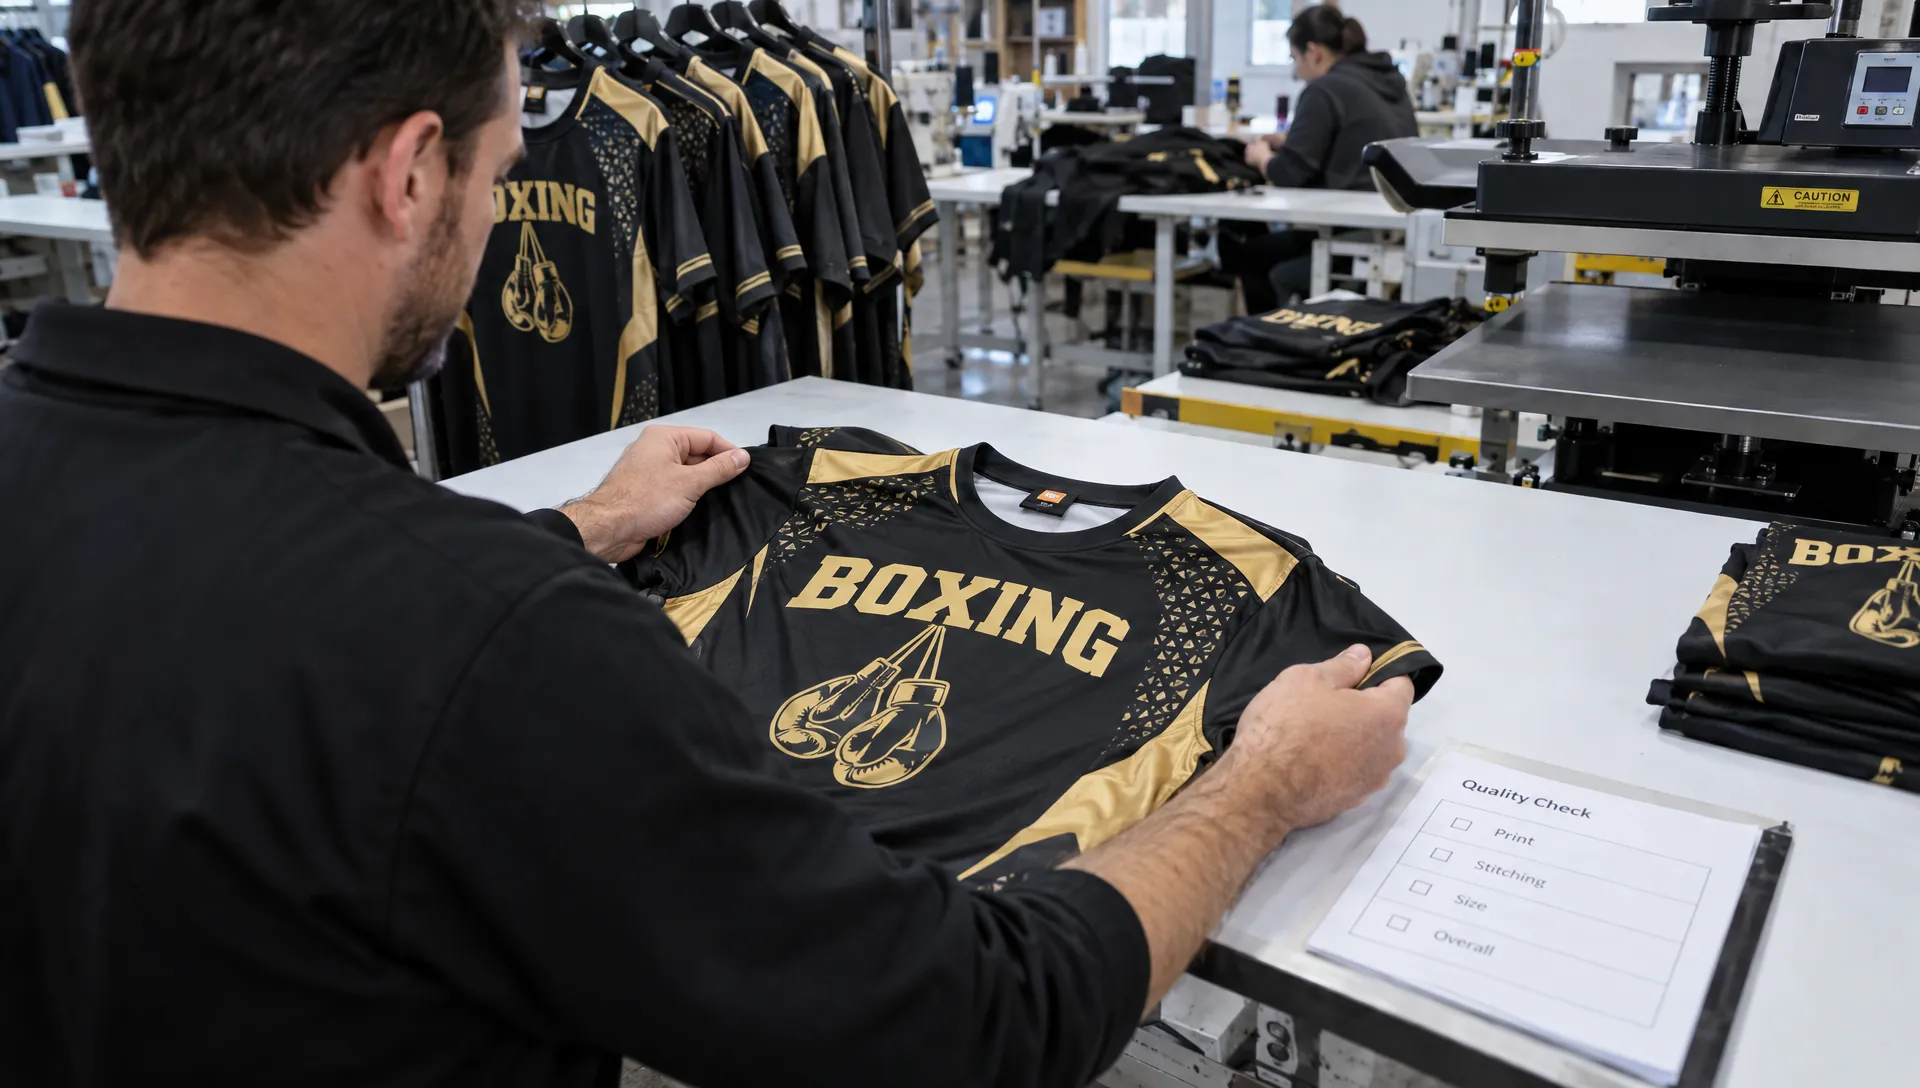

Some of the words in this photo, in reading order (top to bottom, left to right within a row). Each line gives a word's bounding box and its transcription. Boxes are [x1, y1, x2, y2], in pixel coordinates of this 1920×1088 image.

[1794, 191, 1851, 202] CAUTION
[1788, 538, 1920, 566] BOX
[785, 555, 1131, 678] BOXING
[1462, 779, 1529, 804] Quality
[1534, 797, 1592, 819] Check
[1494, 828, 1536, 846] Print
[1475, 860, 1547, 889] Stitching
[1454, 894, 1487, 912] Size
[1434, 930, 1496, 956] Overall
